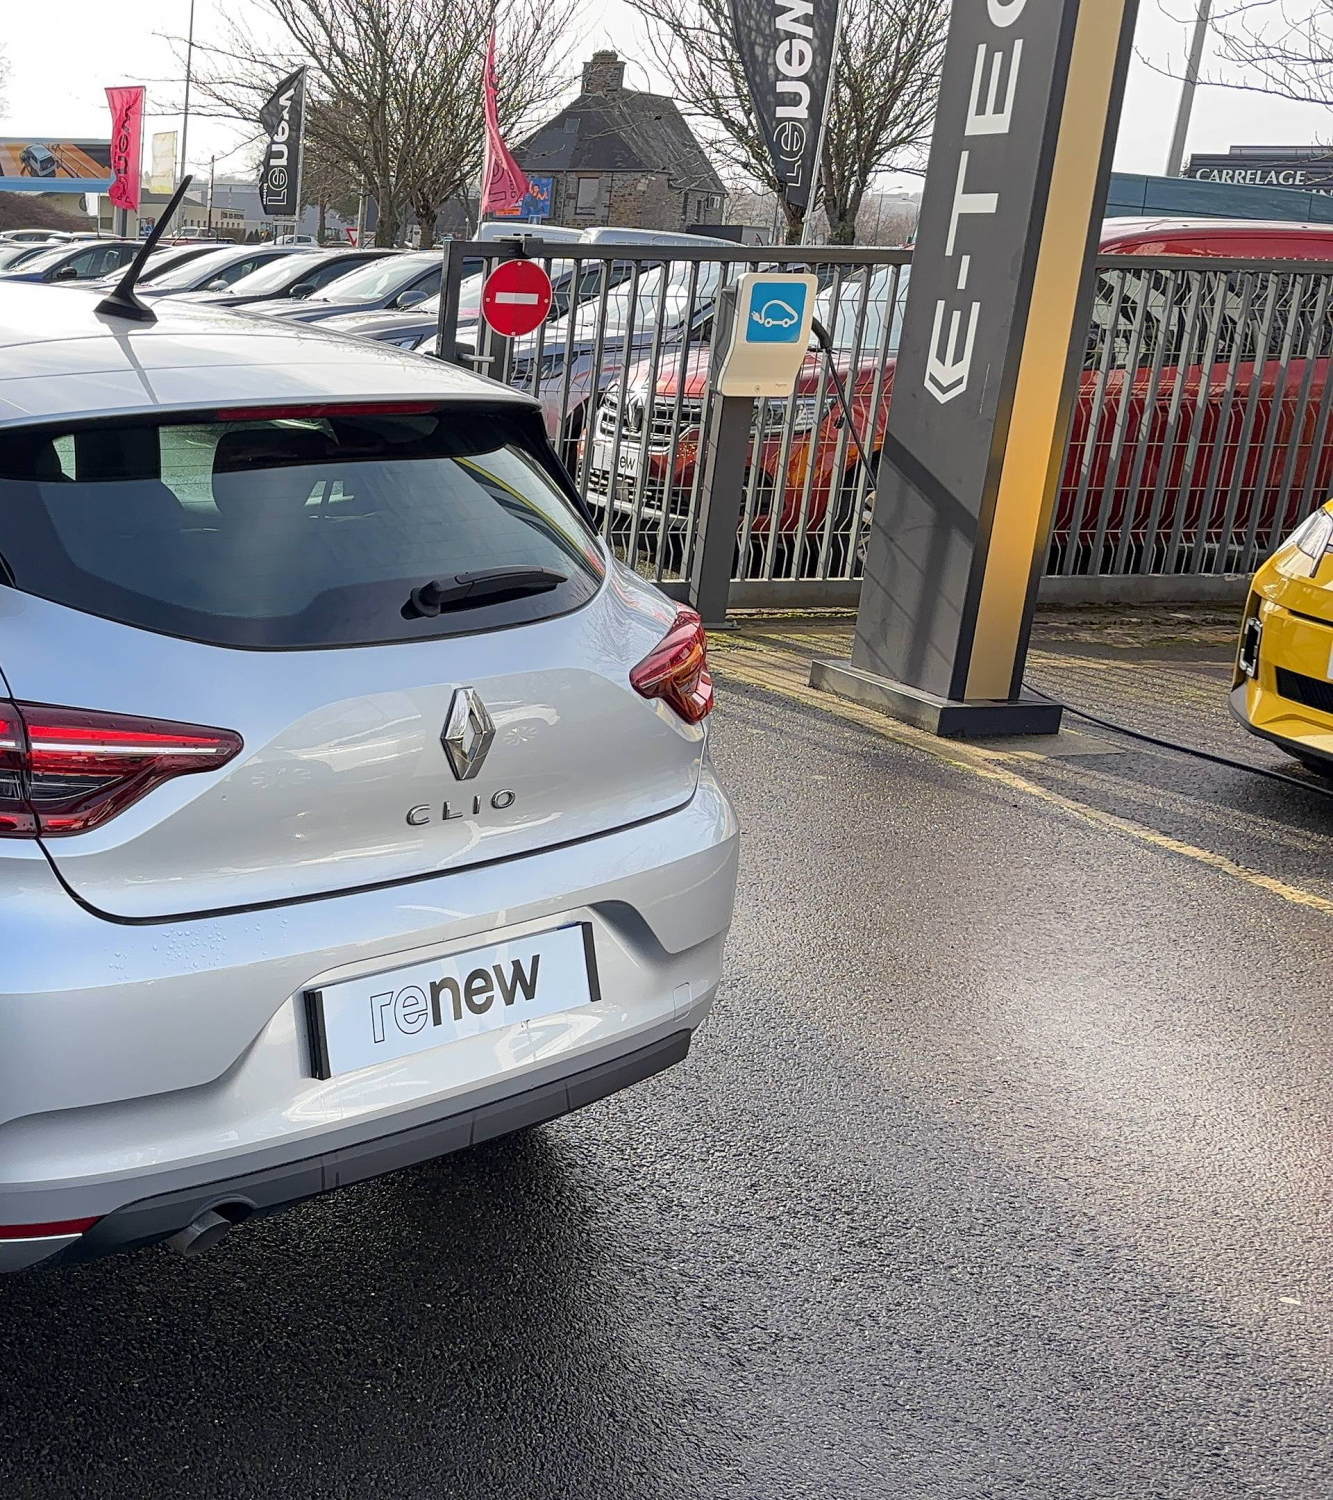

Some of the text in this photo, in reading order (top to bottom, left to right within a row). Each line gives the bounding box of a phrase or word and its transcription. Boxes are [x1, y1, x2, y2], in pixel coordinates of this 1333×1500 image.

[1196, 168, 1306, 185] CARRELAGE
[405, 788, 516, 826] CLIO
[370, 954, 540, 1044] renew
